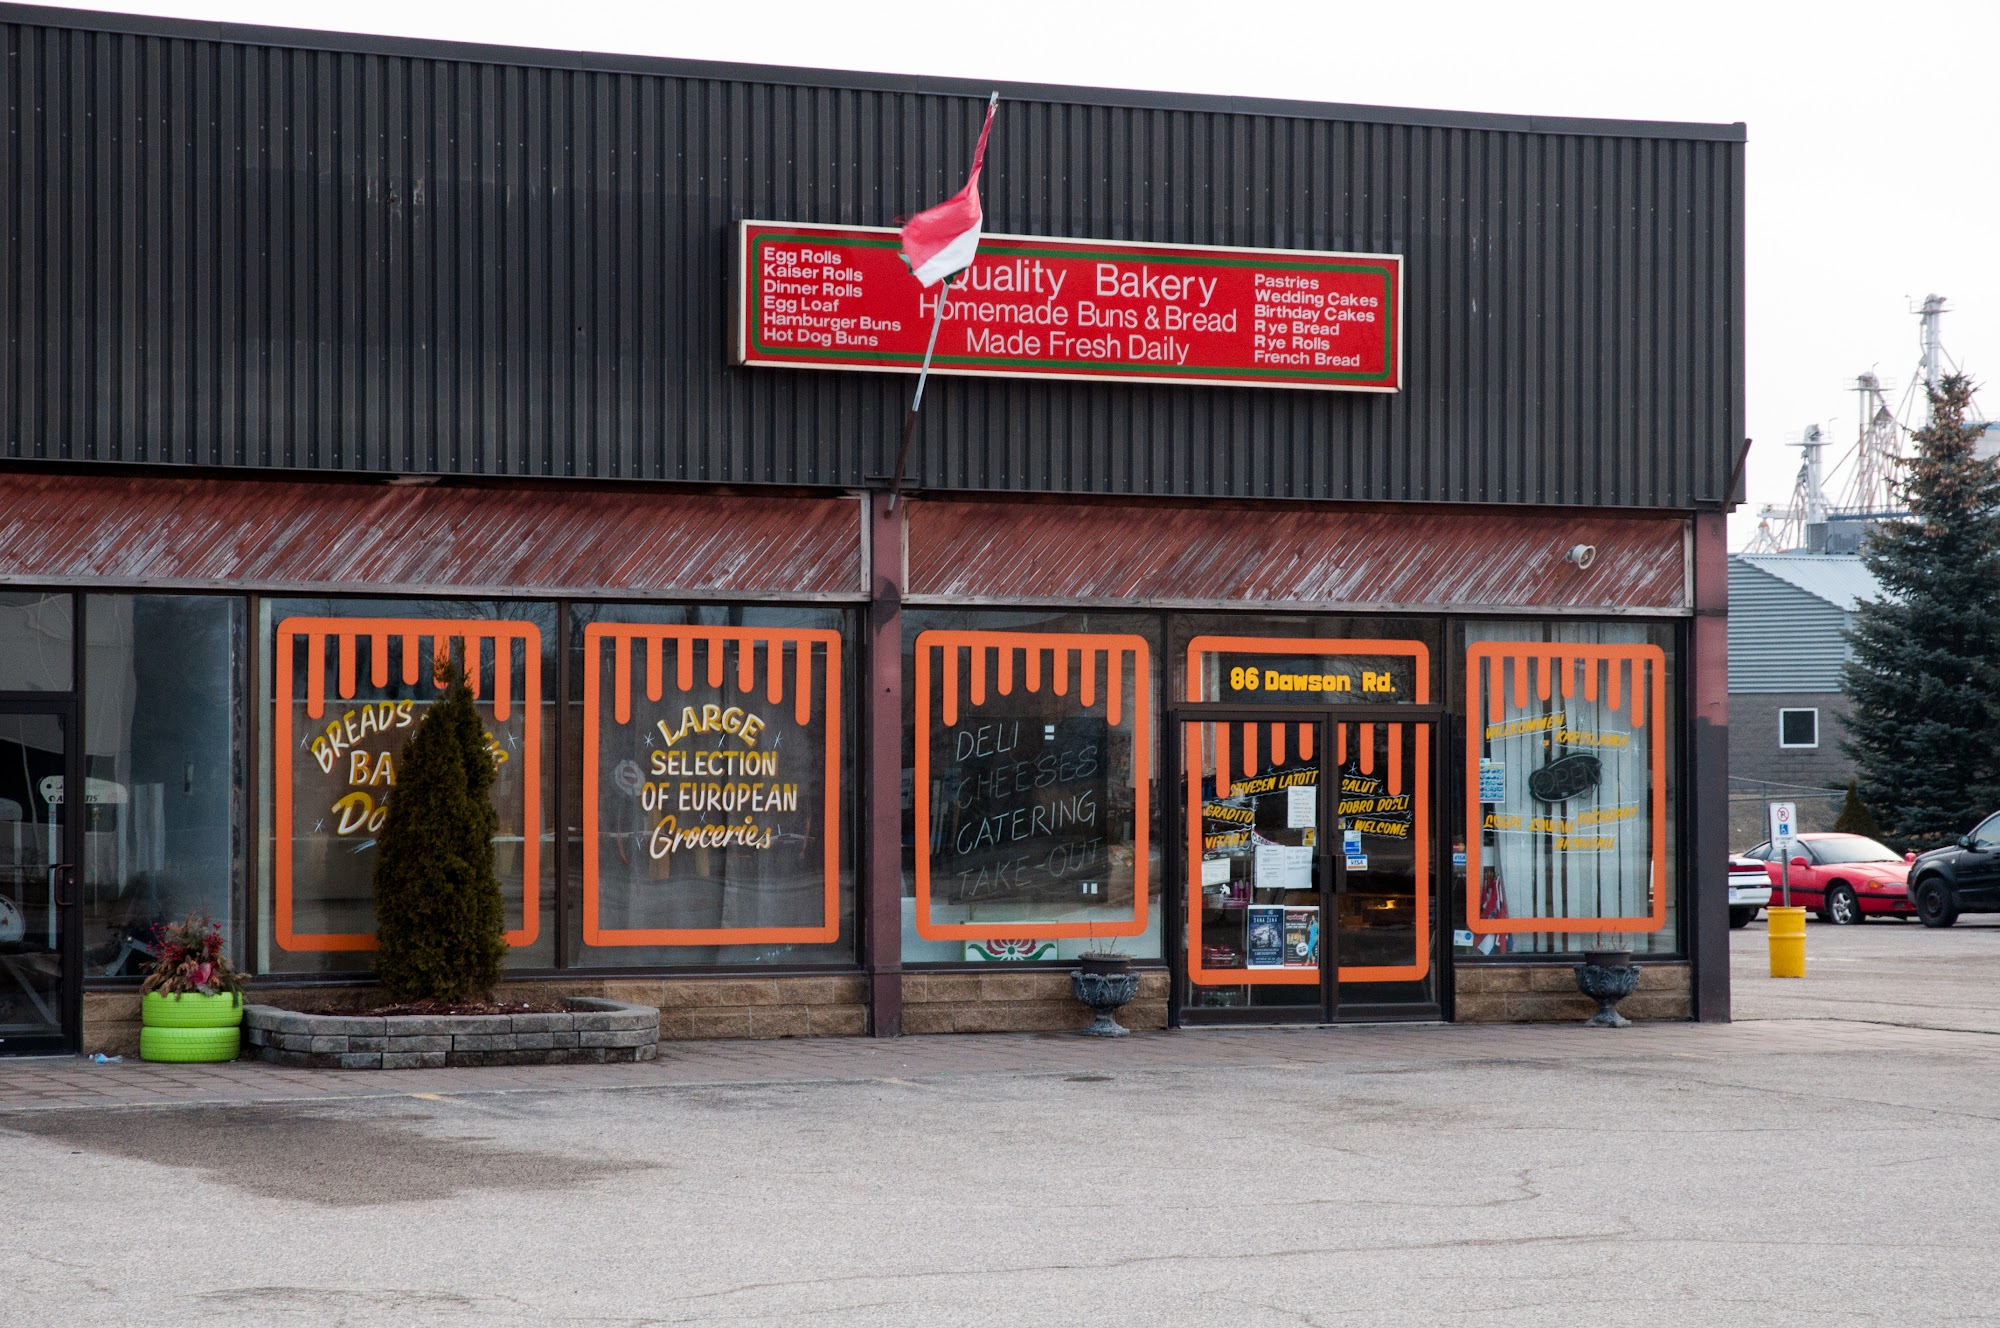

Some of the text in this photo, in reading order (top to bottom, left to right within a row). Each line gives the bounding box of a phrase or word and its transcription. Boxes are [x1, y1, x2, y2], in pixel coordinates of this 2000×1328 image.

[763, 247, 842, 265] Egg Rolls
[763, 263, 864, 282] Kaiser Rolls
[1254, 273, 1320, 289] Pastries
[763, 279, 863, 298] Dinner Rolls
[948, 259, 1218, 308] Quality Bakery
[763, 295, 840, 313] Egg Loaf
[1254, 289, 1379, 308] Wedding Cakes
[763, 311, 902, 332] Hamburger Buns
[919, 292, 1237, 333] Homemade Buns & Bread
[1254, 304, 1376, 323] Birthday Cakes
[763, 327, 879, 347] Hot Dog Buns
[1254, 320, 1340, 336] Rye Bread
[966, 327, 1191, 365] Made Fresh Daily
[1254, 335, 1331, 351] Rye Rolls
[1254, 350, 1360, 367] French Bread
[1229, 666, 1396, 693] 86 Dawson Rd.
[656, 703, 766, 748] LARGE
[1486, 714, 1564, 740] WILLKOMMEN
[311, 699, 415, 774] BREADS
[955, 720, 1019, 763] DELI
[650, 749, 778, 778] SELECTION
[956, 745, 1098, 810] CHEESES
[1341, 778, 1379, 794] SALUT
[641, 781, 799, 813] OF EUROPEAN
[1337, 799, 1375, 815] DOBRO
[956, 788, 1097, 855] CATERING
[1204, 804, 1255, 823] GRADITO
[649, 814, 772, 859] Groceries
[1354, 820, 1409, 836] WELCOME
[1204, 831, 1249, 849] VITANY
[956, 837, 1103, 900] TAKE-OUT
